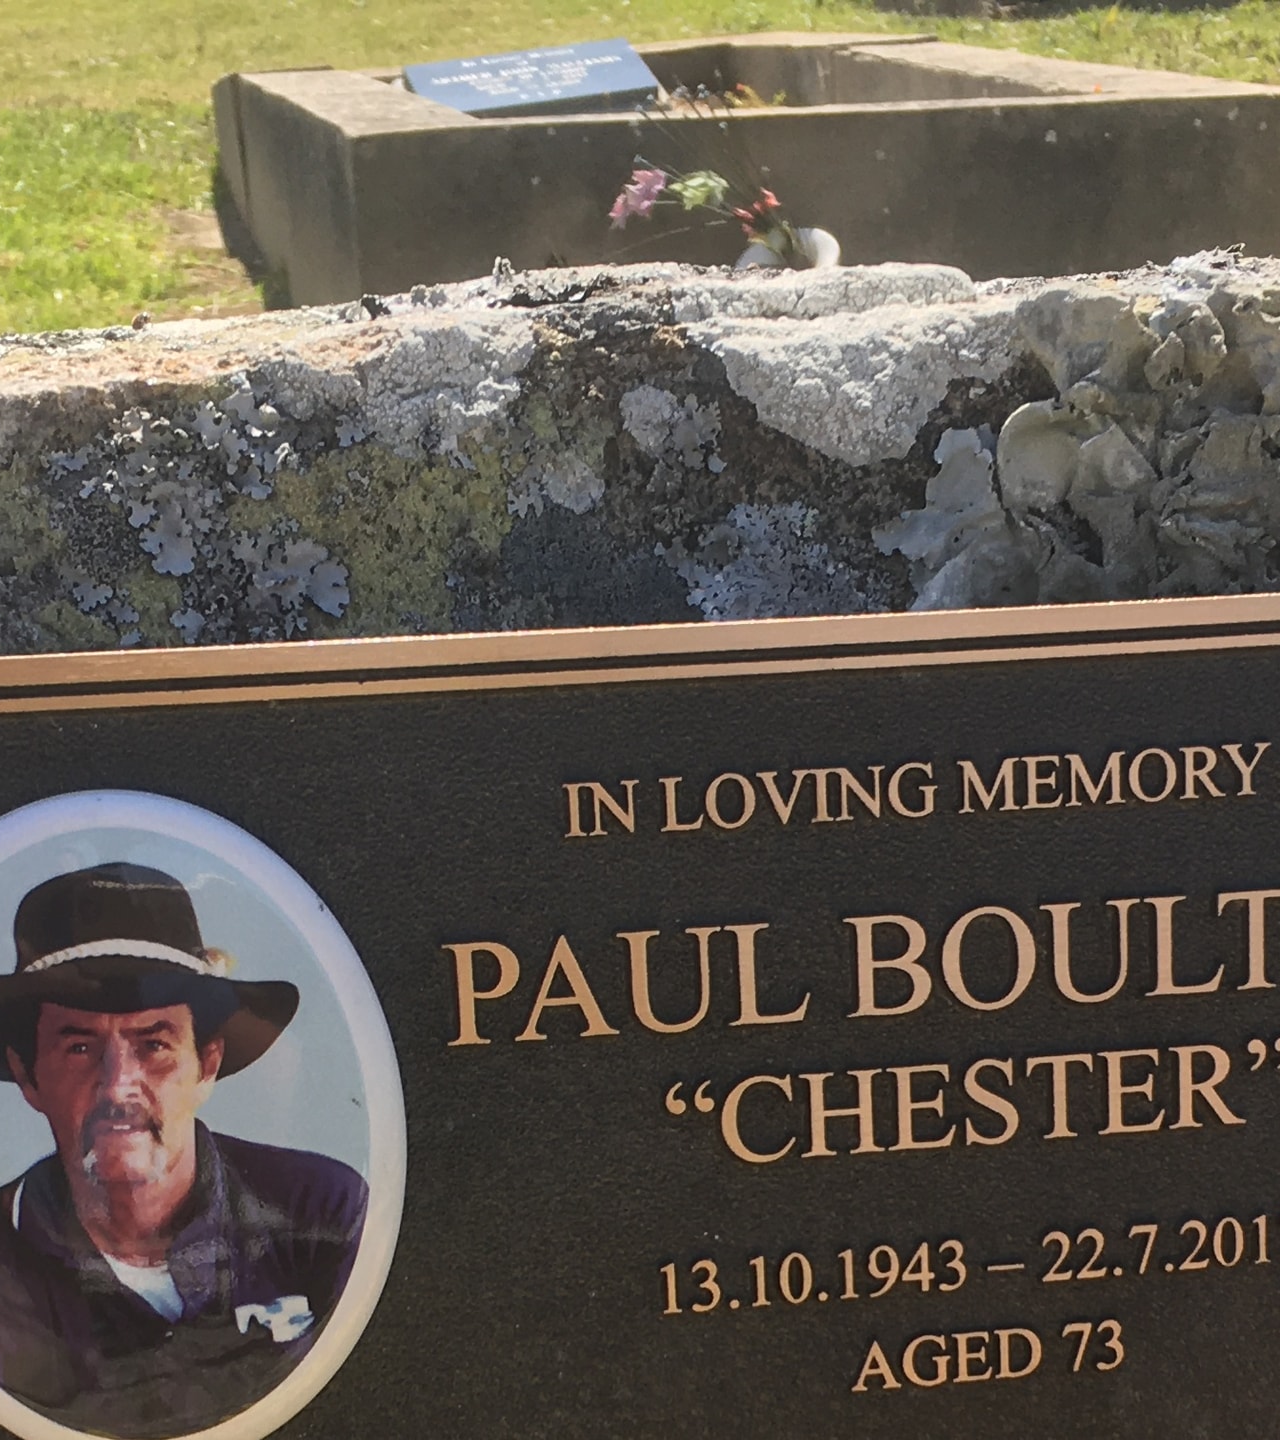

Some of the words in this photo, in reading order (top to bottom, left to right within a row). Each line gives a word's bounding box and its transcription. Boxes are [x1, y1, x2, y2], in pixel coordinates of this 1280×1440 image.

[563, 780, 639, 837] IN
[659, 762, 938, 832] LOVING
[957, 742, 1271, 813] MEMORY
[442, 923, 810, 1046] PAUL
[661, 1240, 966, 1314] 13.10.1943
[852, 1329, 1041, 1391] AGED
[1062, 1320, 1124, 1371] 73
